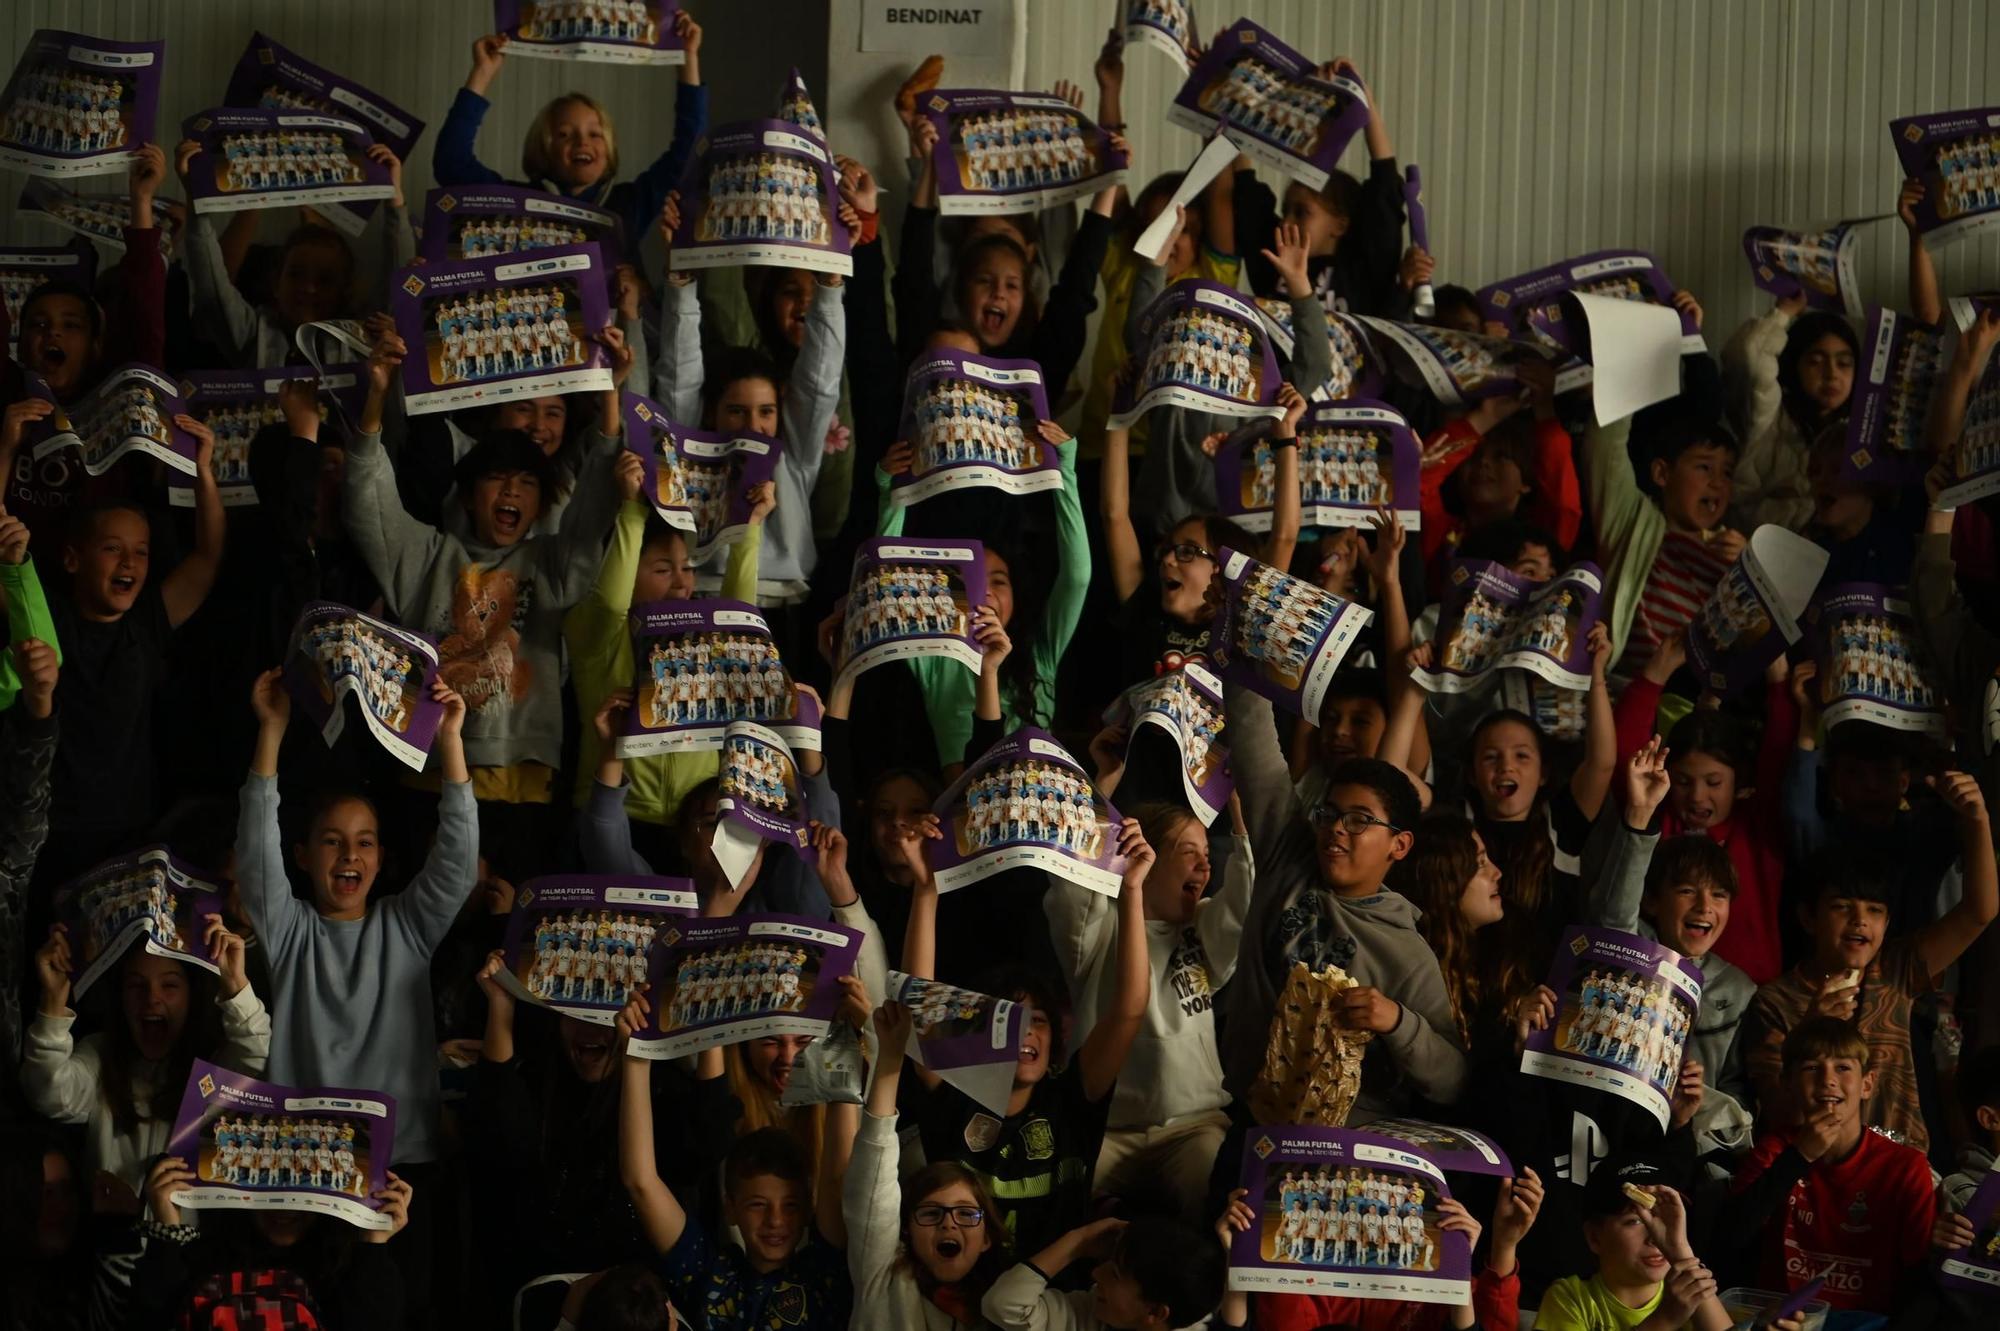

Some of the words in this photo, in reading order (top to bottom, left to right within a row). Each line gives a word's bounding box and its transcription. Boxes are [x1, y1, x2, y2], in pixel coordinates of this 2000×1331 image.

[887, 9, 982, 25] BENDINAT
[430, 274, 457, 283] PALMA
[457, 270, 486, 278] FUTSAL
[674, 612, 703, 620] FUTSAL
[1595, 940, 1622, 953] PALMA
[1622, 946, 1650, 962] FUTSAL
[220, 1084, 245, 1098] PALMA
[245, 1090, 274, 1103] FUTSAL
[1281, 1139, 1310, 1147] PALMA
[1311, 1140, 1343, 1150] FUTSAL
